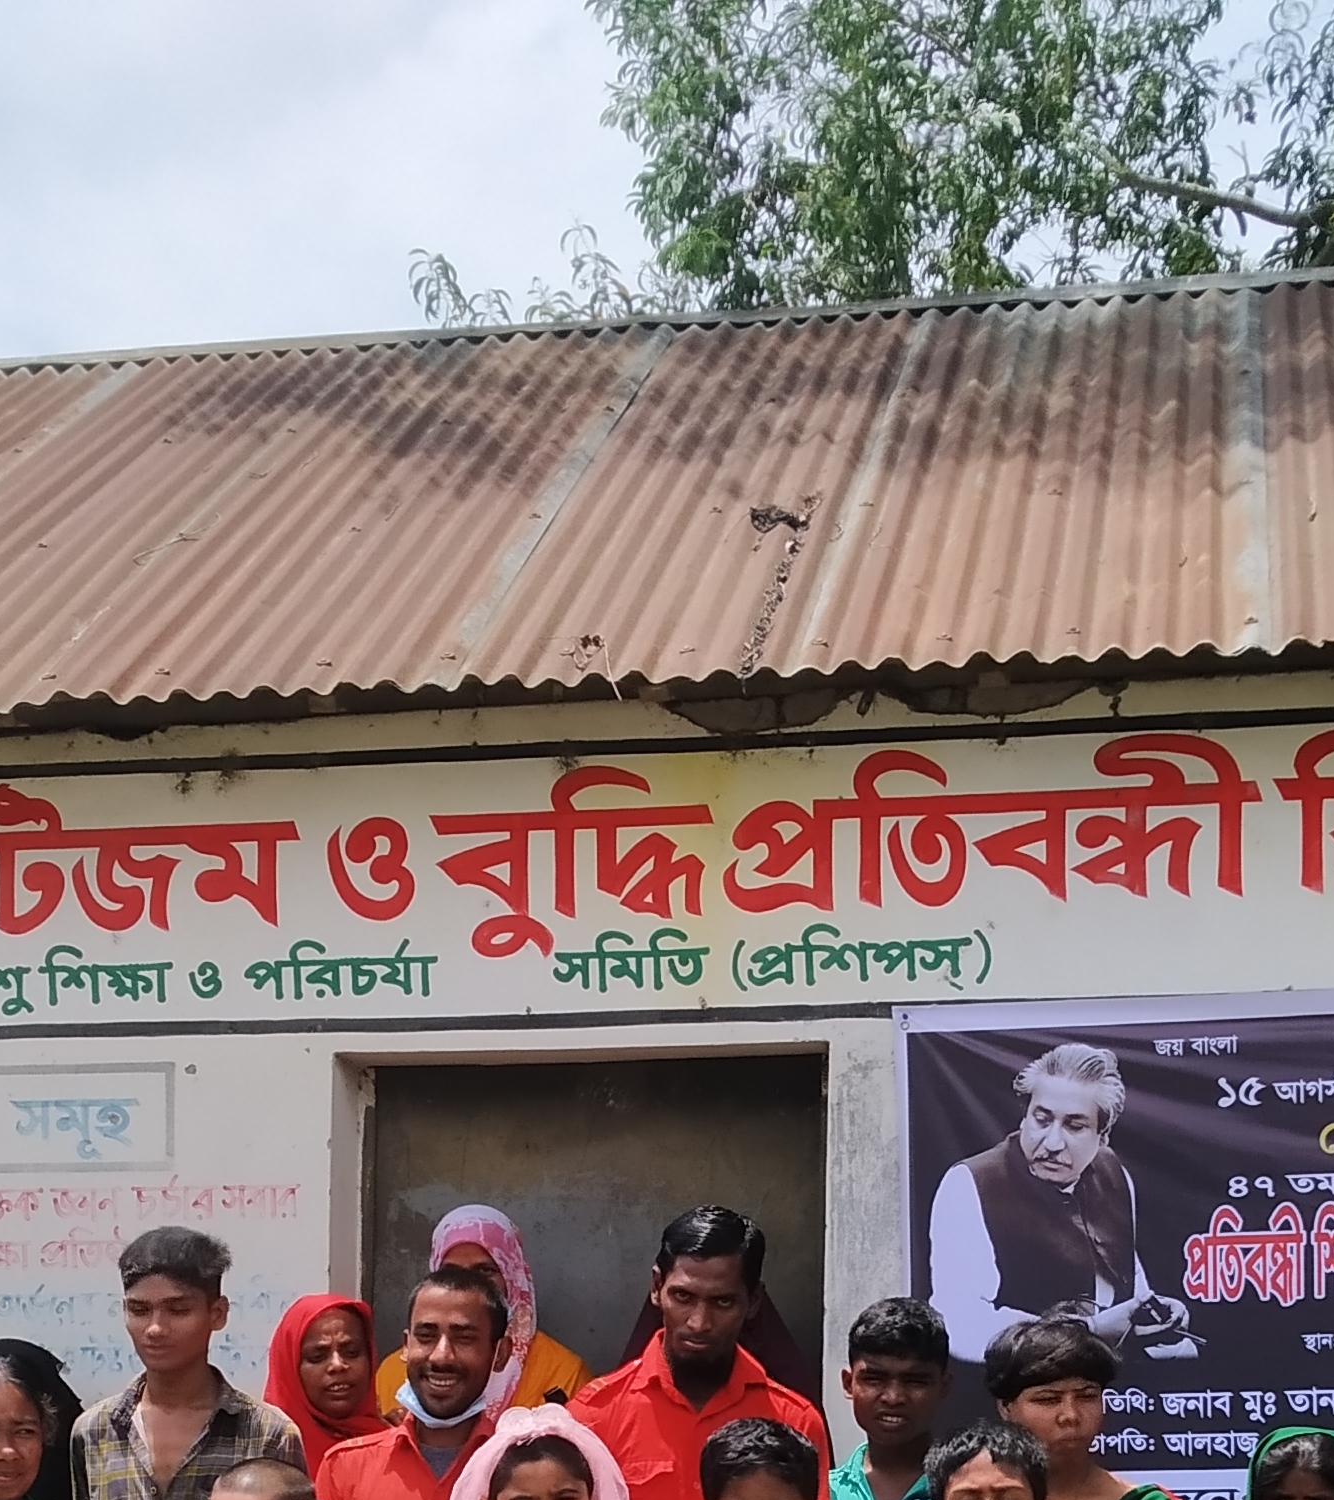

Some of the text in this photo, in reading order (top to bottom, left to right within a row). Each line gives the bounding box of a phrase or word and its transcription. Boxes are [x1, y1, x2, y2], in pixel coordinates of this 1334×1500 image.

[326, 815, 416, 923] ও
[429, 765, 716, 960] বুদ্ধি
[722, 728, 1261, 915] প্রতিবন্ধী
[40, 944, 173, 1006] শিক্ষা
[188, 961, 223, 999] ও
[244, 938, 437, 1002] পরিচর্যা
[552, 927, 710, 993] সমিতি
[732, 923, 992, 992] (প্রশিপস্)
[1153, 1035, 1238, 1057] জয় বাংলা
[1217, 1075, 1267, 1108] ১৫
[9, 1096, 140, 1160] সমূহ
[1227, 1175, 1276, 1198] ৪৭
[1183, 1201, 1307, 1307] প্রতিবন্ধী
[1159, 1389, 1234, 1418] জনাব
[1239, 1390, 1277, 1424] মুঃ
